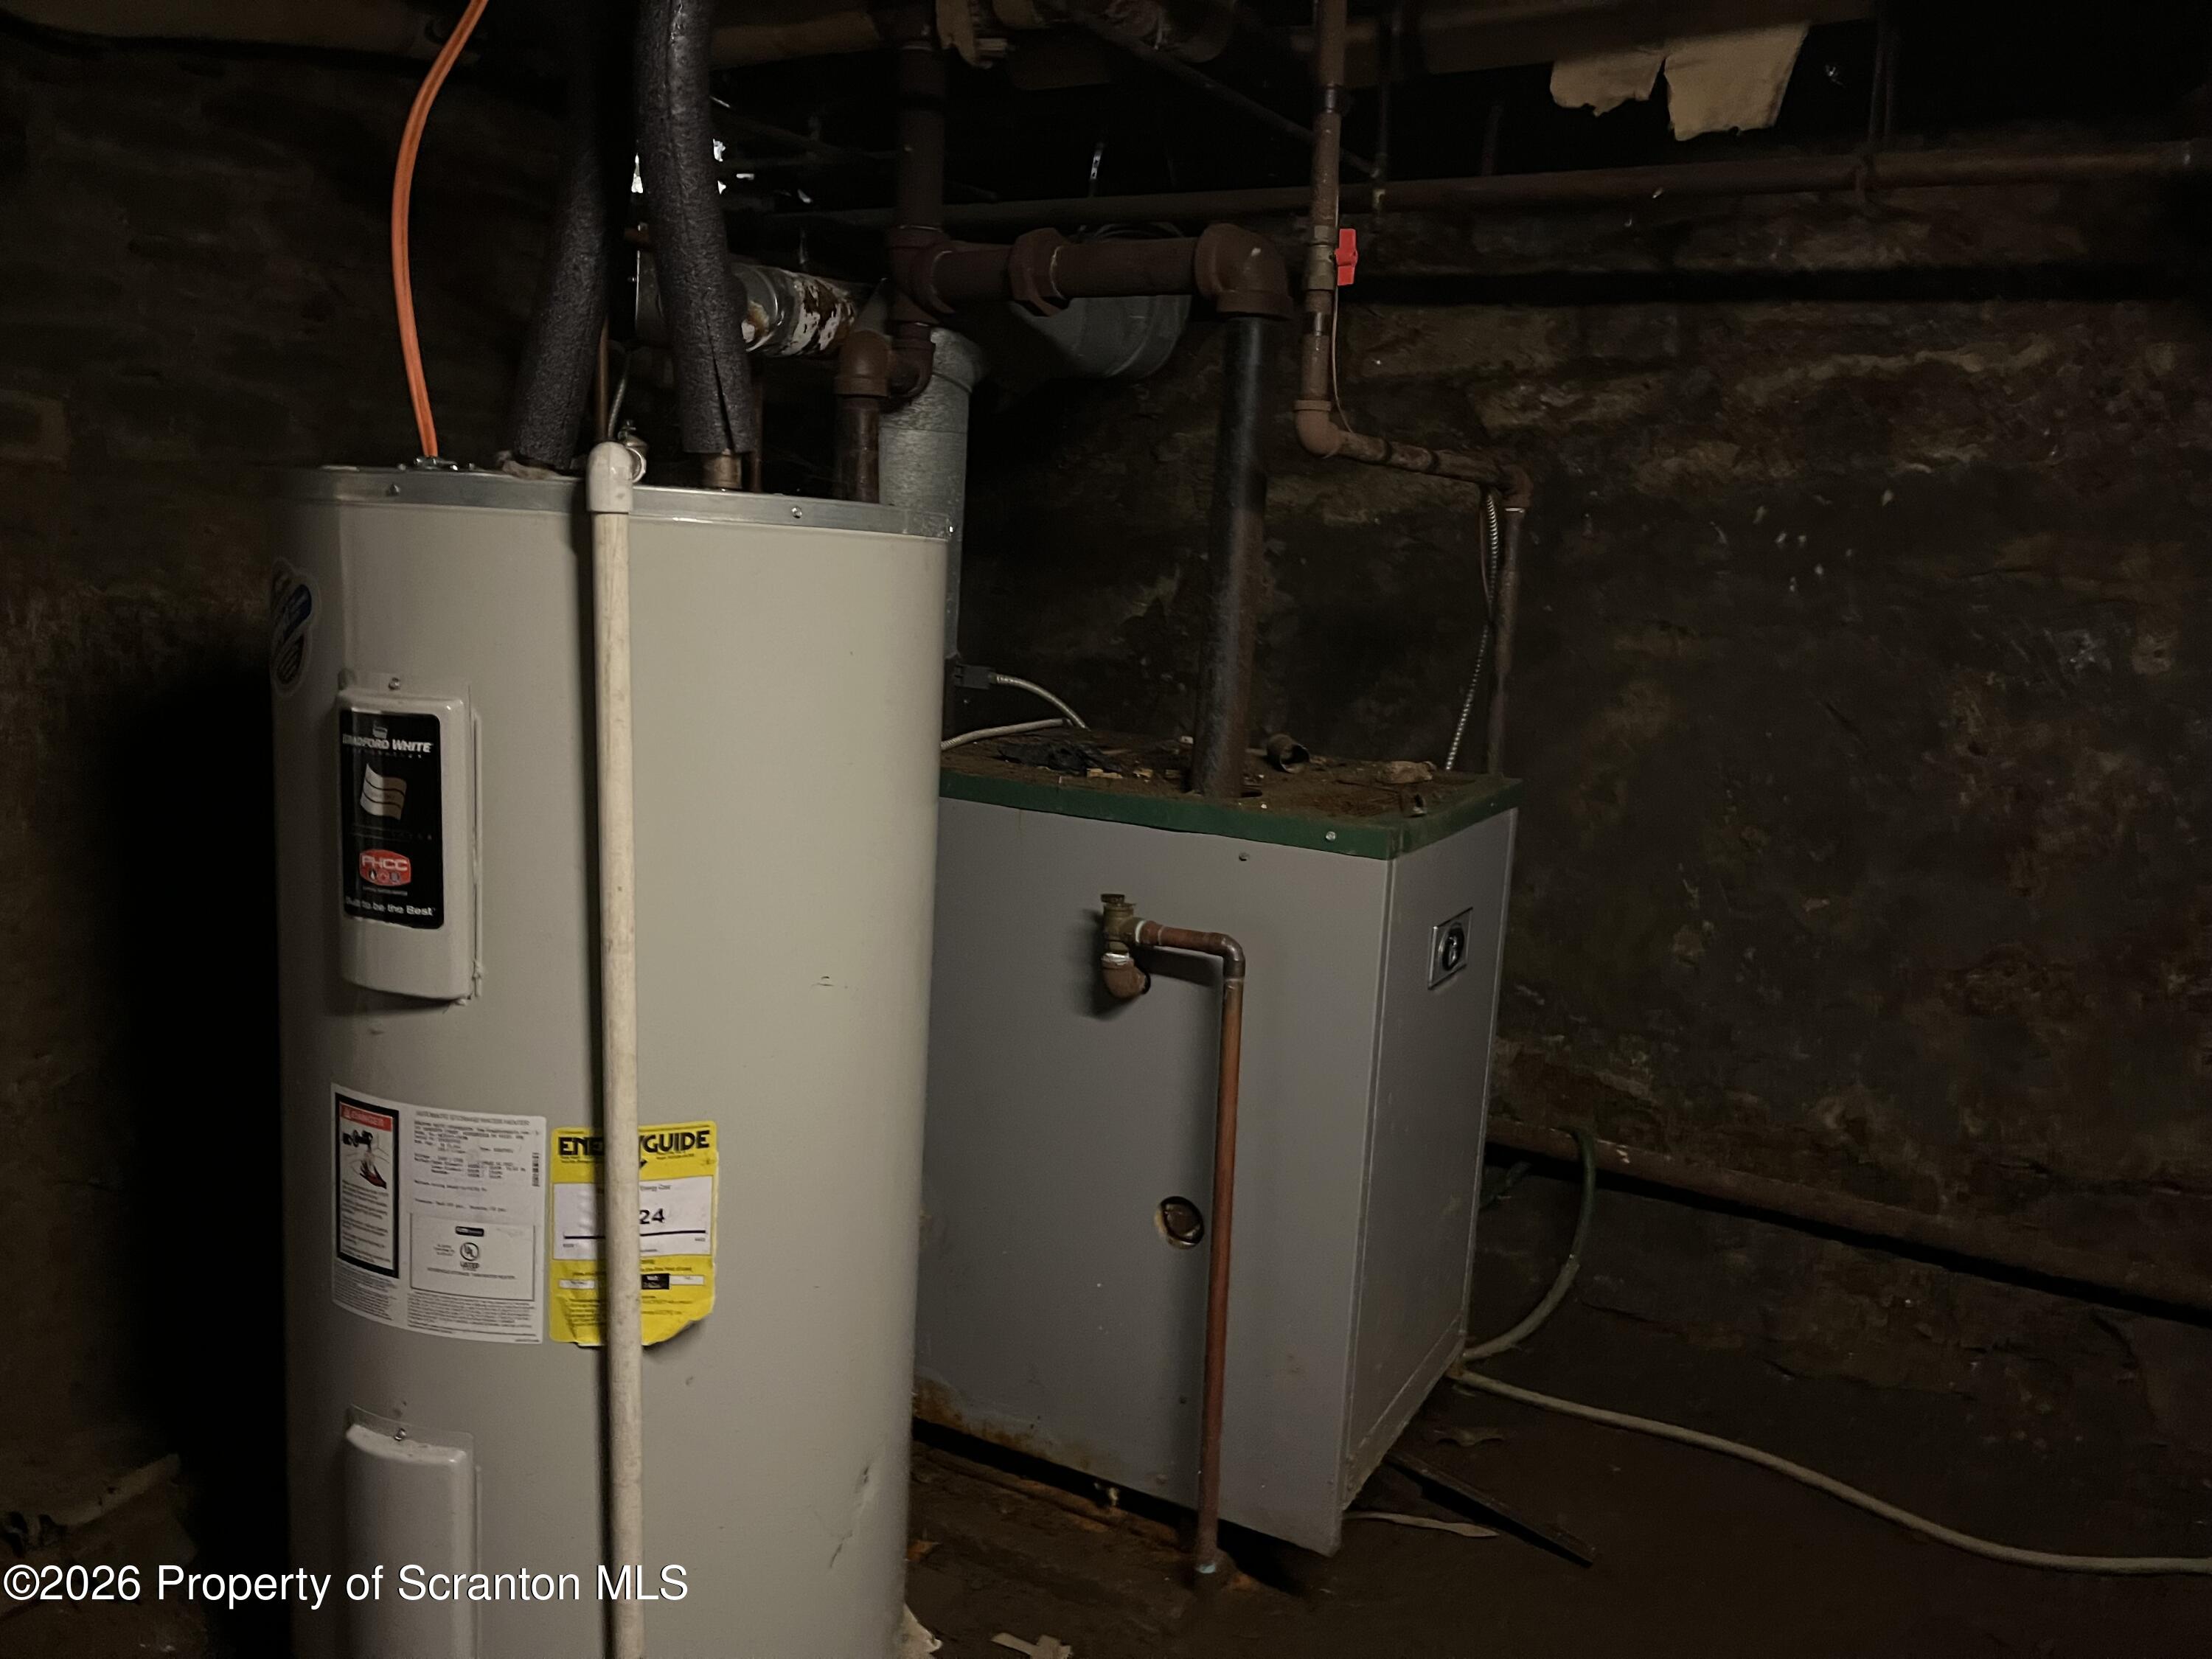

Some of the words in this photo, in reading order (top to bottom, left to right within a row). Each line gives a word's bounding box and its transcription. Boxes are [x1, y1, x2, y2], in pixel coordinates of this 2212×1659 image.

[392, 739, 432, 753] WHITE
[361, 855, 407, 872] PHCC
[387, 904, 404, 914] the
[406, 905, 434, 916] Best
[558, 1130, 710, 1155] ENEGUIDE
